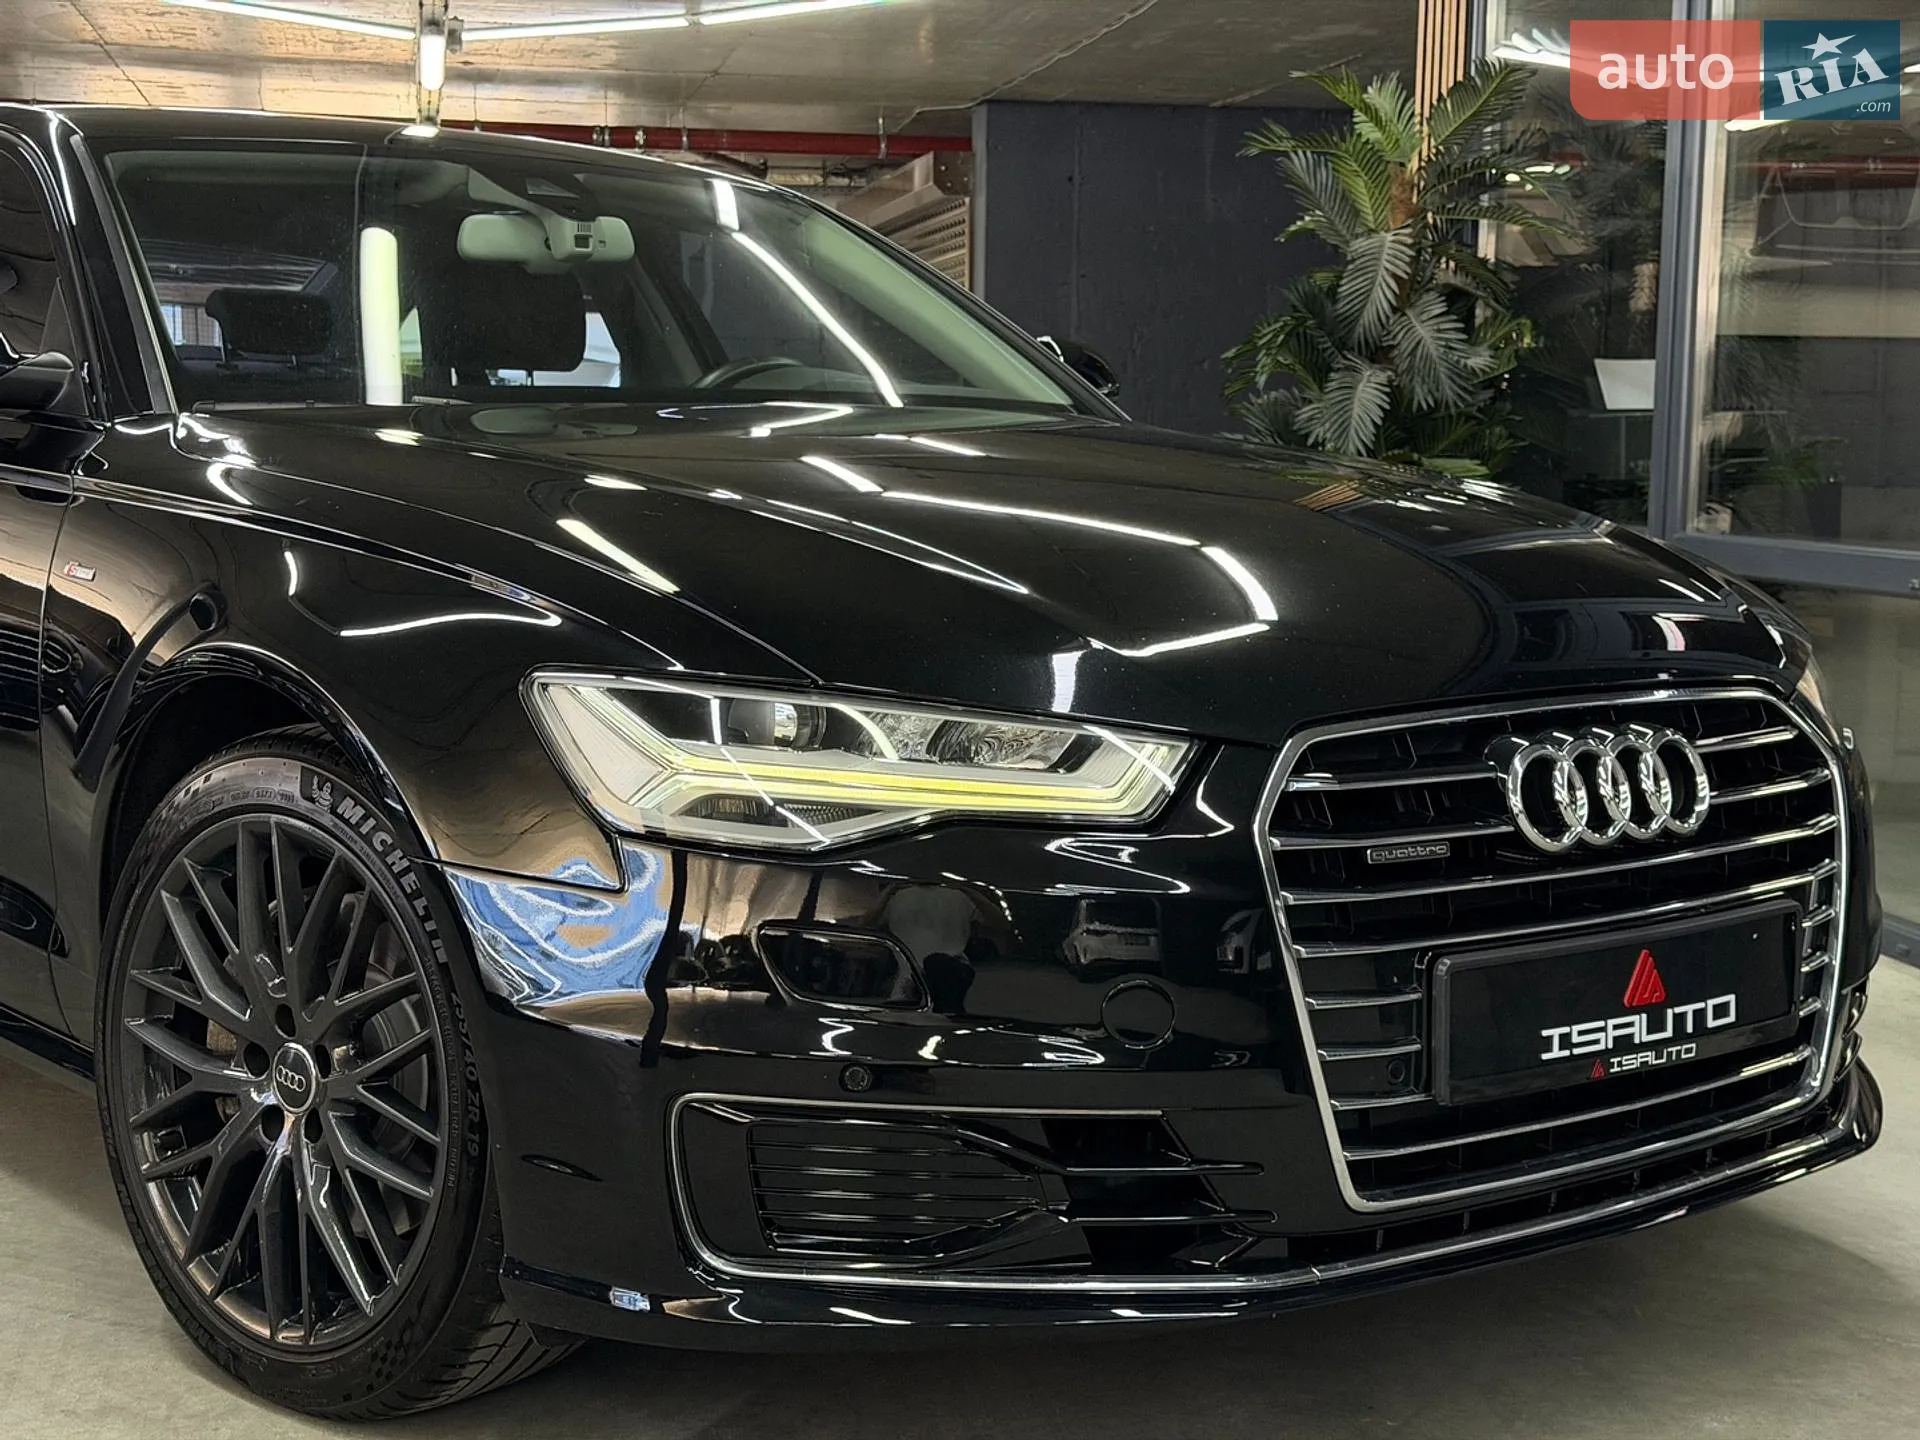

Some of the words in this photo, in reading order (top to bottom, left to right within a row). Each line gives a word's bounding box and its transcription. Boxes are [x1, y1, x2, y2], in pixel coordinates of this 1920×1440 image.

[1372, 845, 1447, 862] quattro
[336, 796, 448, 964] MICHELIN
[1541, 993, 1736, 1060] ISAUTO
[1609, 1042, 1696, 1073] ISAUTO
